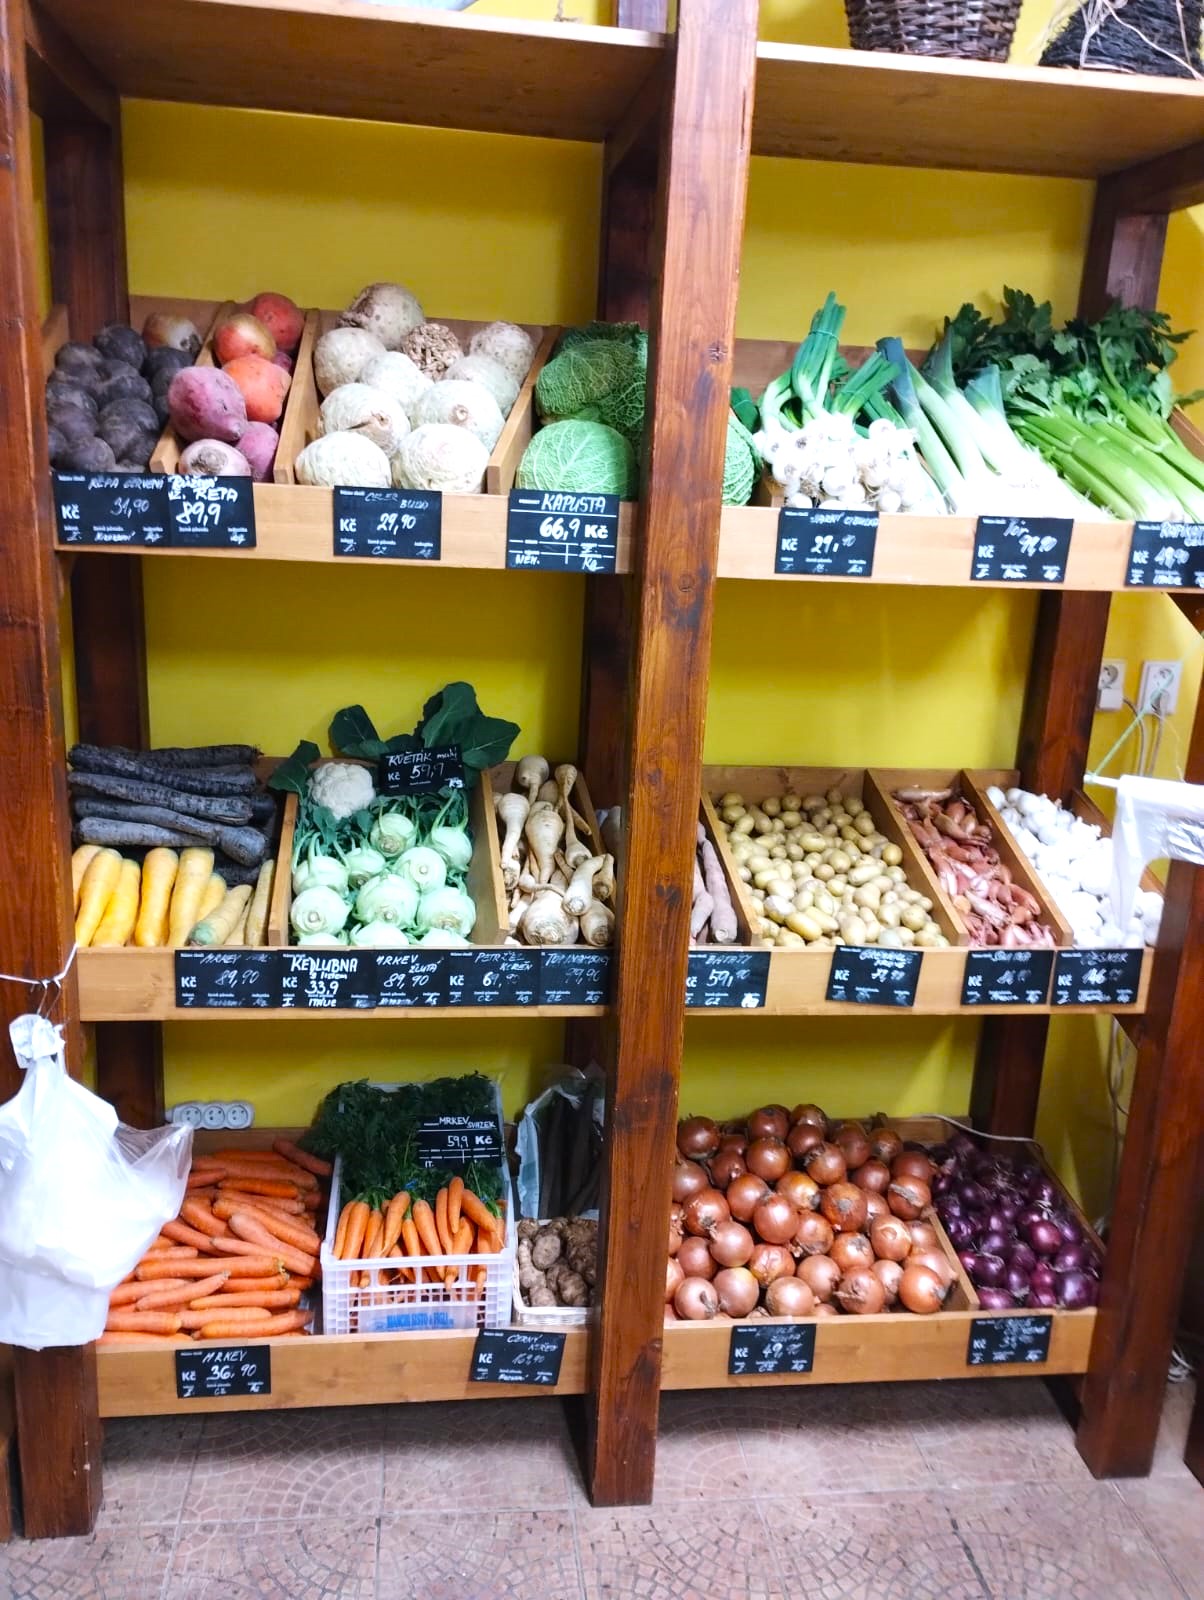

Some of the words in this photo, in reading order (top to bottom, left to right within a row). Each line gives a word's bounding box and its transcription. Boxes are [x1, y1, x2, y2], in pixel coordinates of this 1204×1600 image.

[541, 493, 606, 513] KAPUSTA
[61, 504, 80, 519] Kč
[176, 501, 221, 526] 89,9
[340, 518, 357, 532] Kč
[539, 517, 580, 541] 66,9
[584, 524, 609, 539] Kč
[781, 538, 798, 551] Kč
[388, 771, 401, 782] Kč
[290, 956, 358, 973] KEDLUBNA
[181, 976, 197, 988] Kč
[283, 976, 298, 988] Kč
[450, 975, 464, 986] Kč
[475, 1135, 493, 1145] Kč
[478, 1352, 492, 1364] Kč
[181, 1370, 196, 1381] Kč
